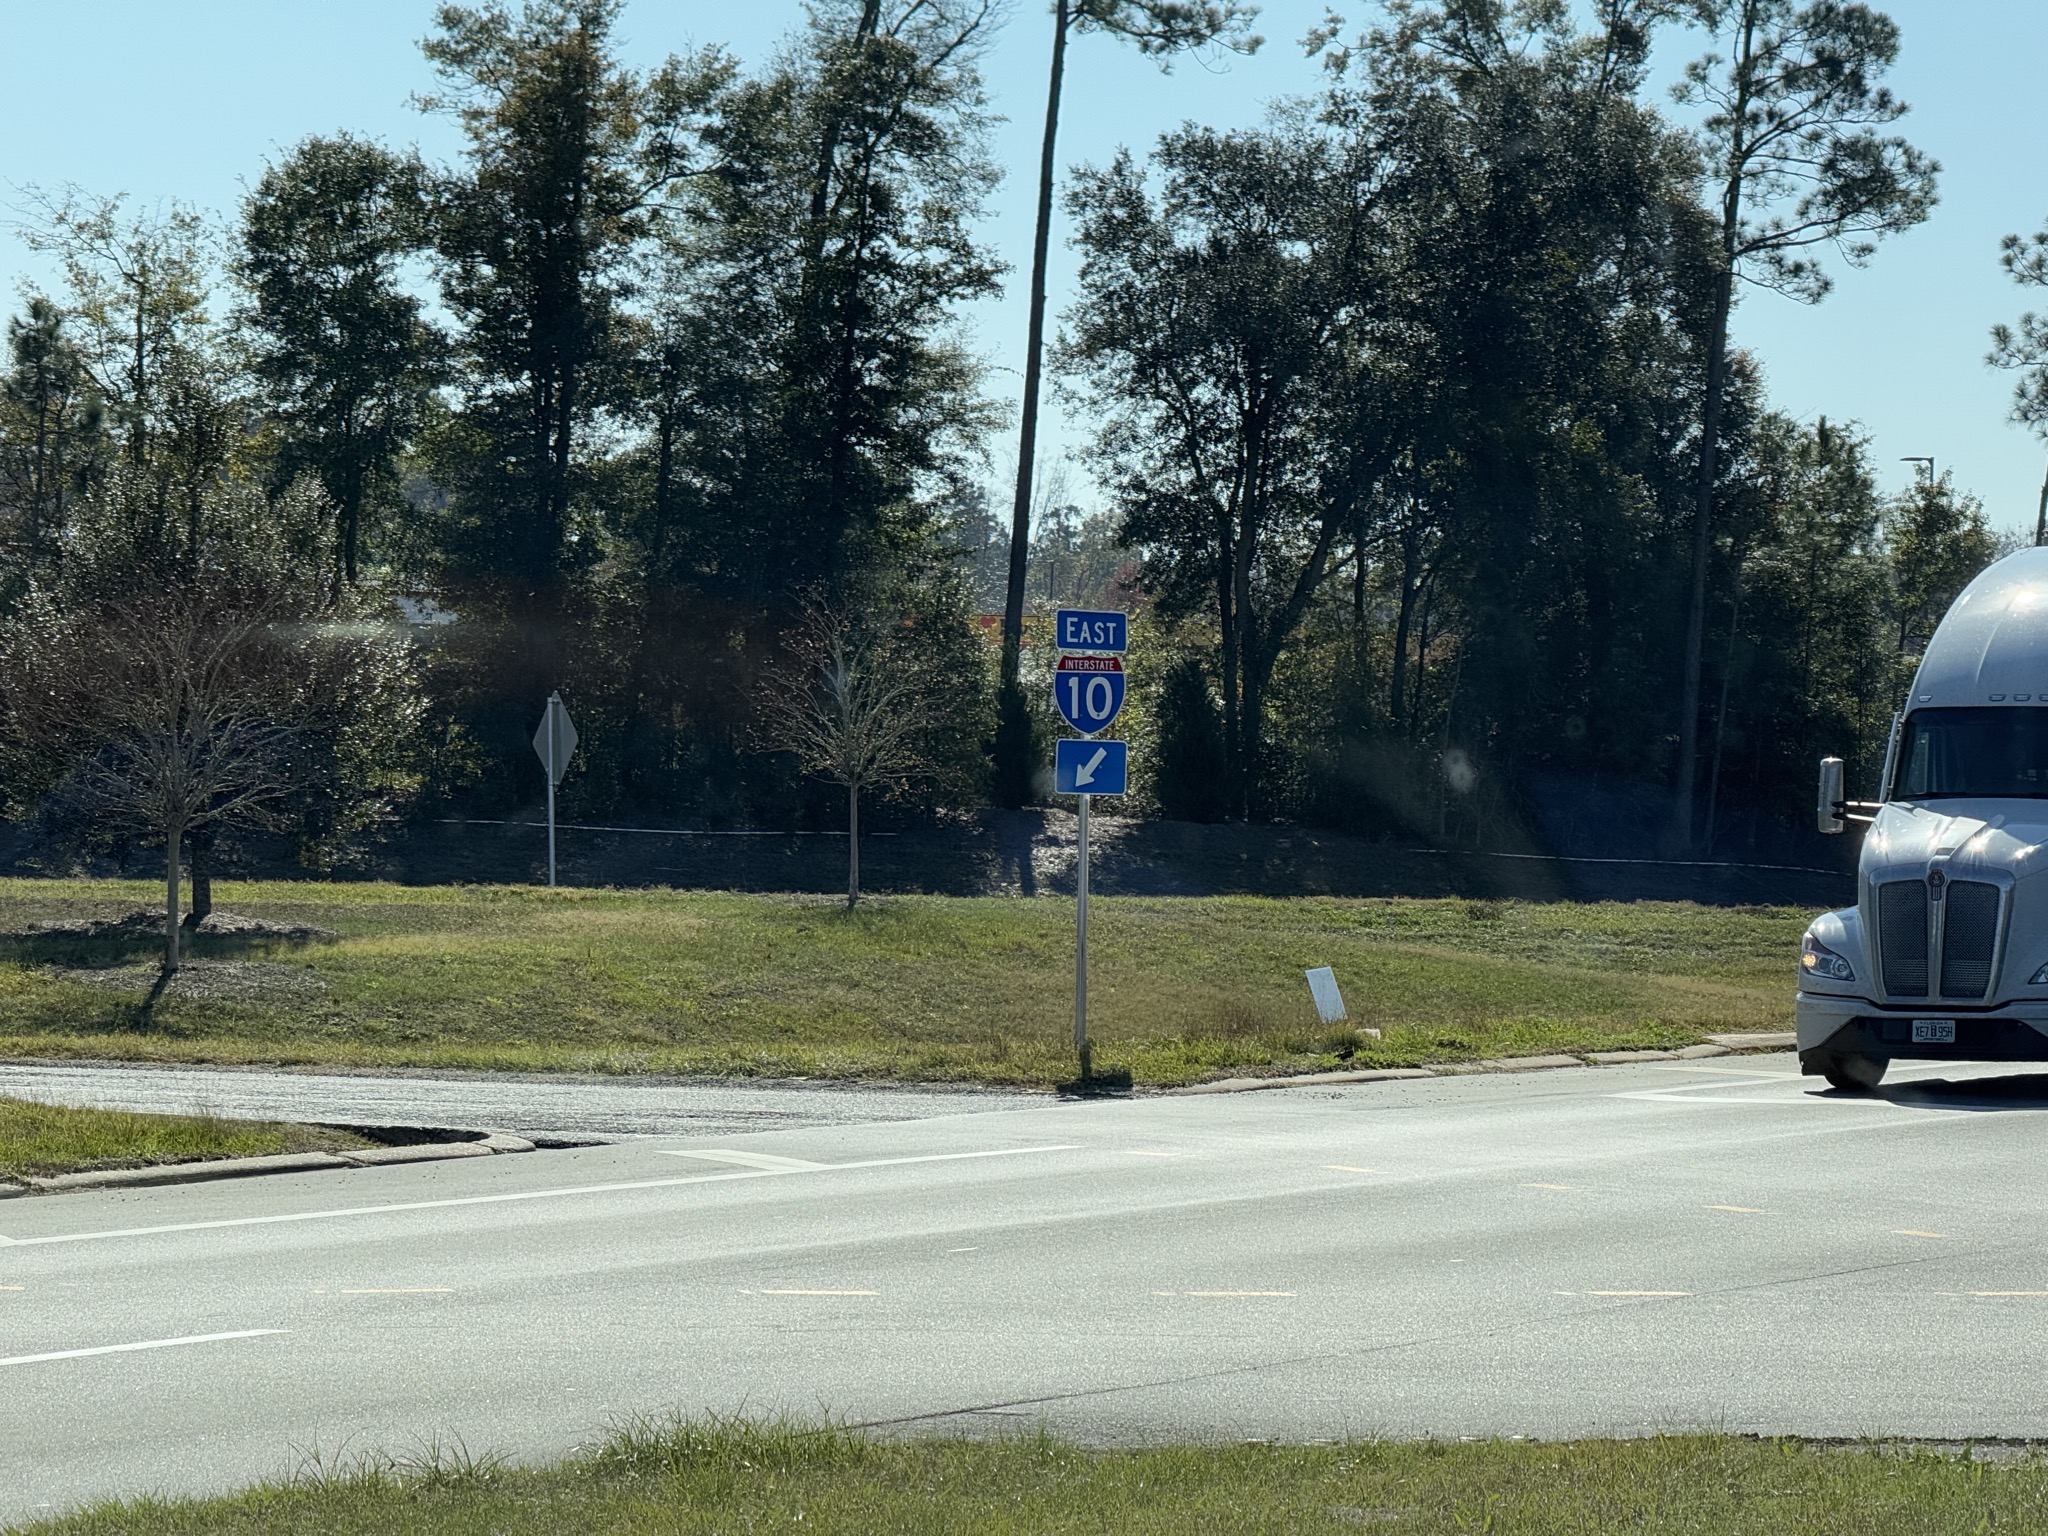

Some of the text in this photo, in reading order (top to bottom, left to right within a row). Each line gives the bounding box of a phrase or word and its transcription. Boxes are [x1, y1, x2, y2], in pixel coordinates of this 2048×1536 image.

[1066, 617, 1117, 645] EAST
[1065, 659, 1115, 671] INTERSTATE
[1068, 676, 1113, 720] 10
